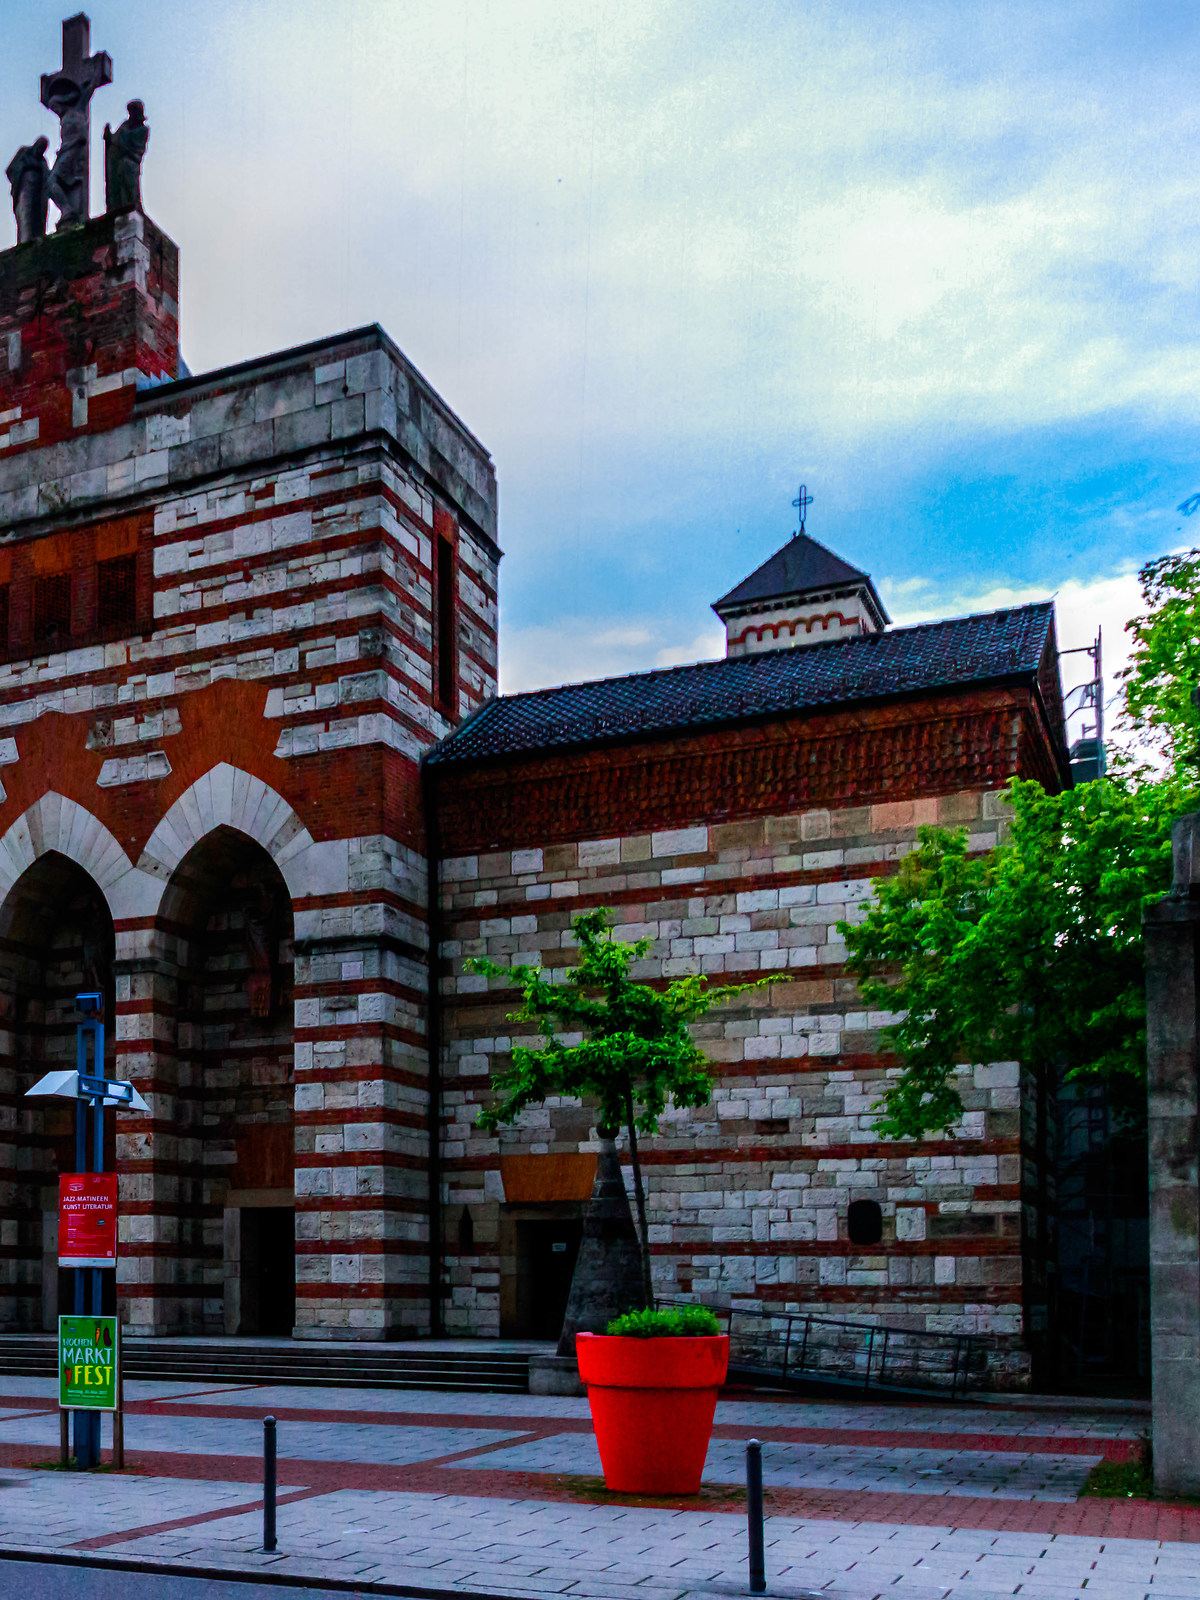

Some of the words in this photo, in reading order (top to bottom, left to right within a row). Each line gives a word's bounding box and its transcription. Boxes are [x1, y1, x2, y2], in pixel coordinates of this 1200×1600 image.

[62, 1337, 93, 1347] WOCHEN
[62, 1347, 113, 1365] MARKT
[74, 1365, 113, 1386] FEST
